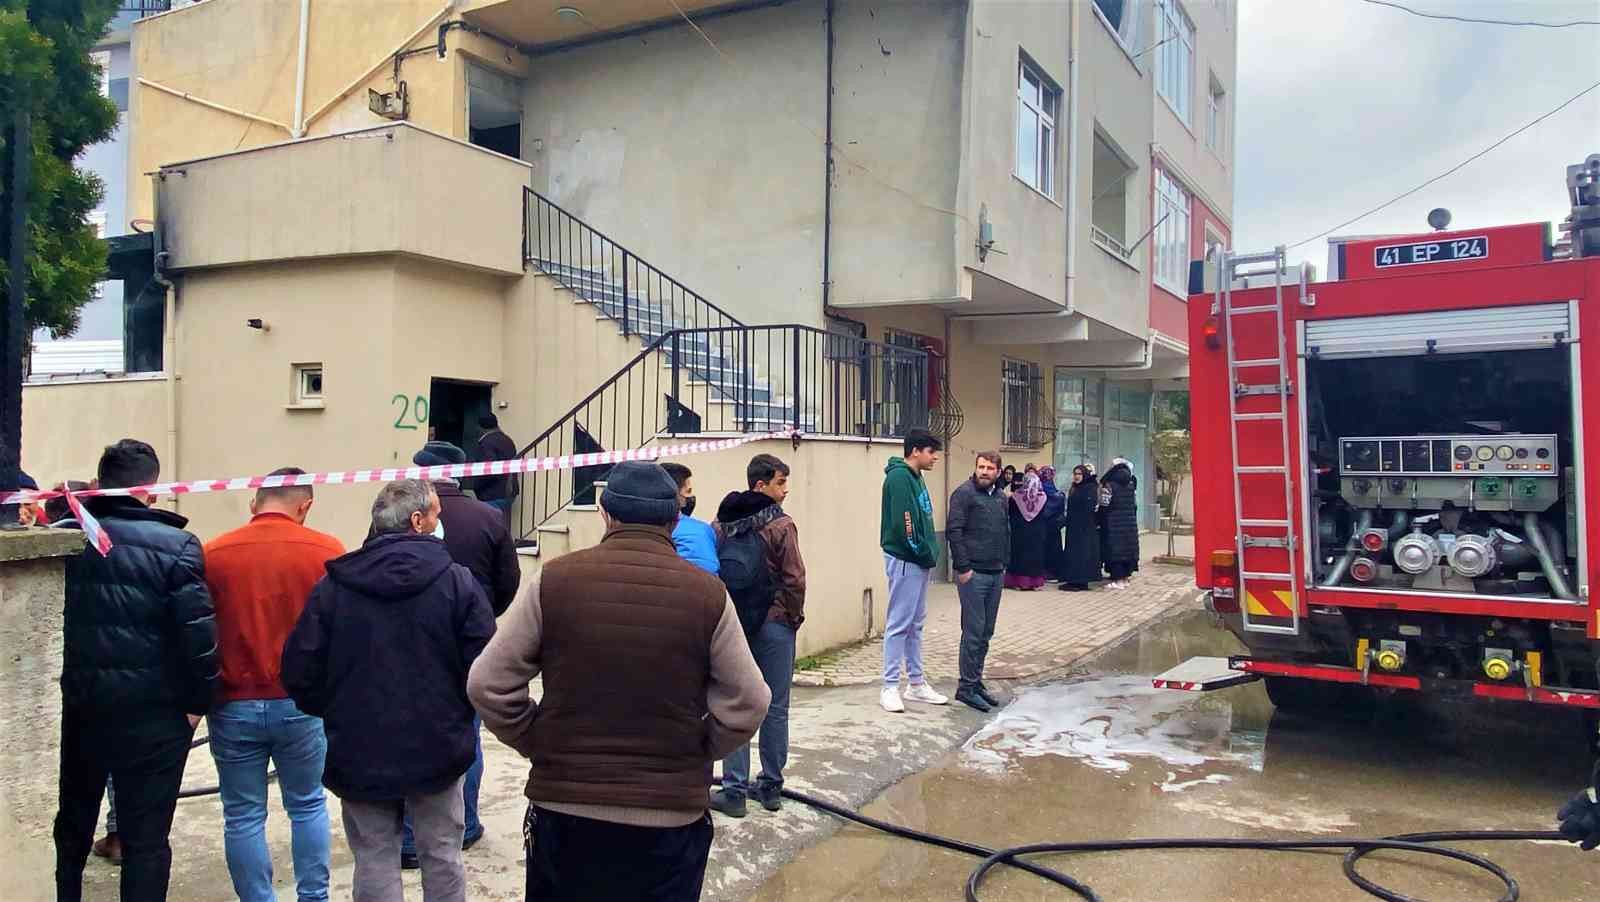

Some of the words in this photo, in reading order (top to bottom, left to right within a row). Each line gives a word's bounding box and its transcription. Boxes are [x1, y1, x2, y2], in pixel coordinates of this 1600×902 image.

[1381, 248, 1400, 265] 41
[1413, 244, 1440, 262] EP
[1450, 240, 1482, 258] 124
[392, 394, 428, 430] 20
